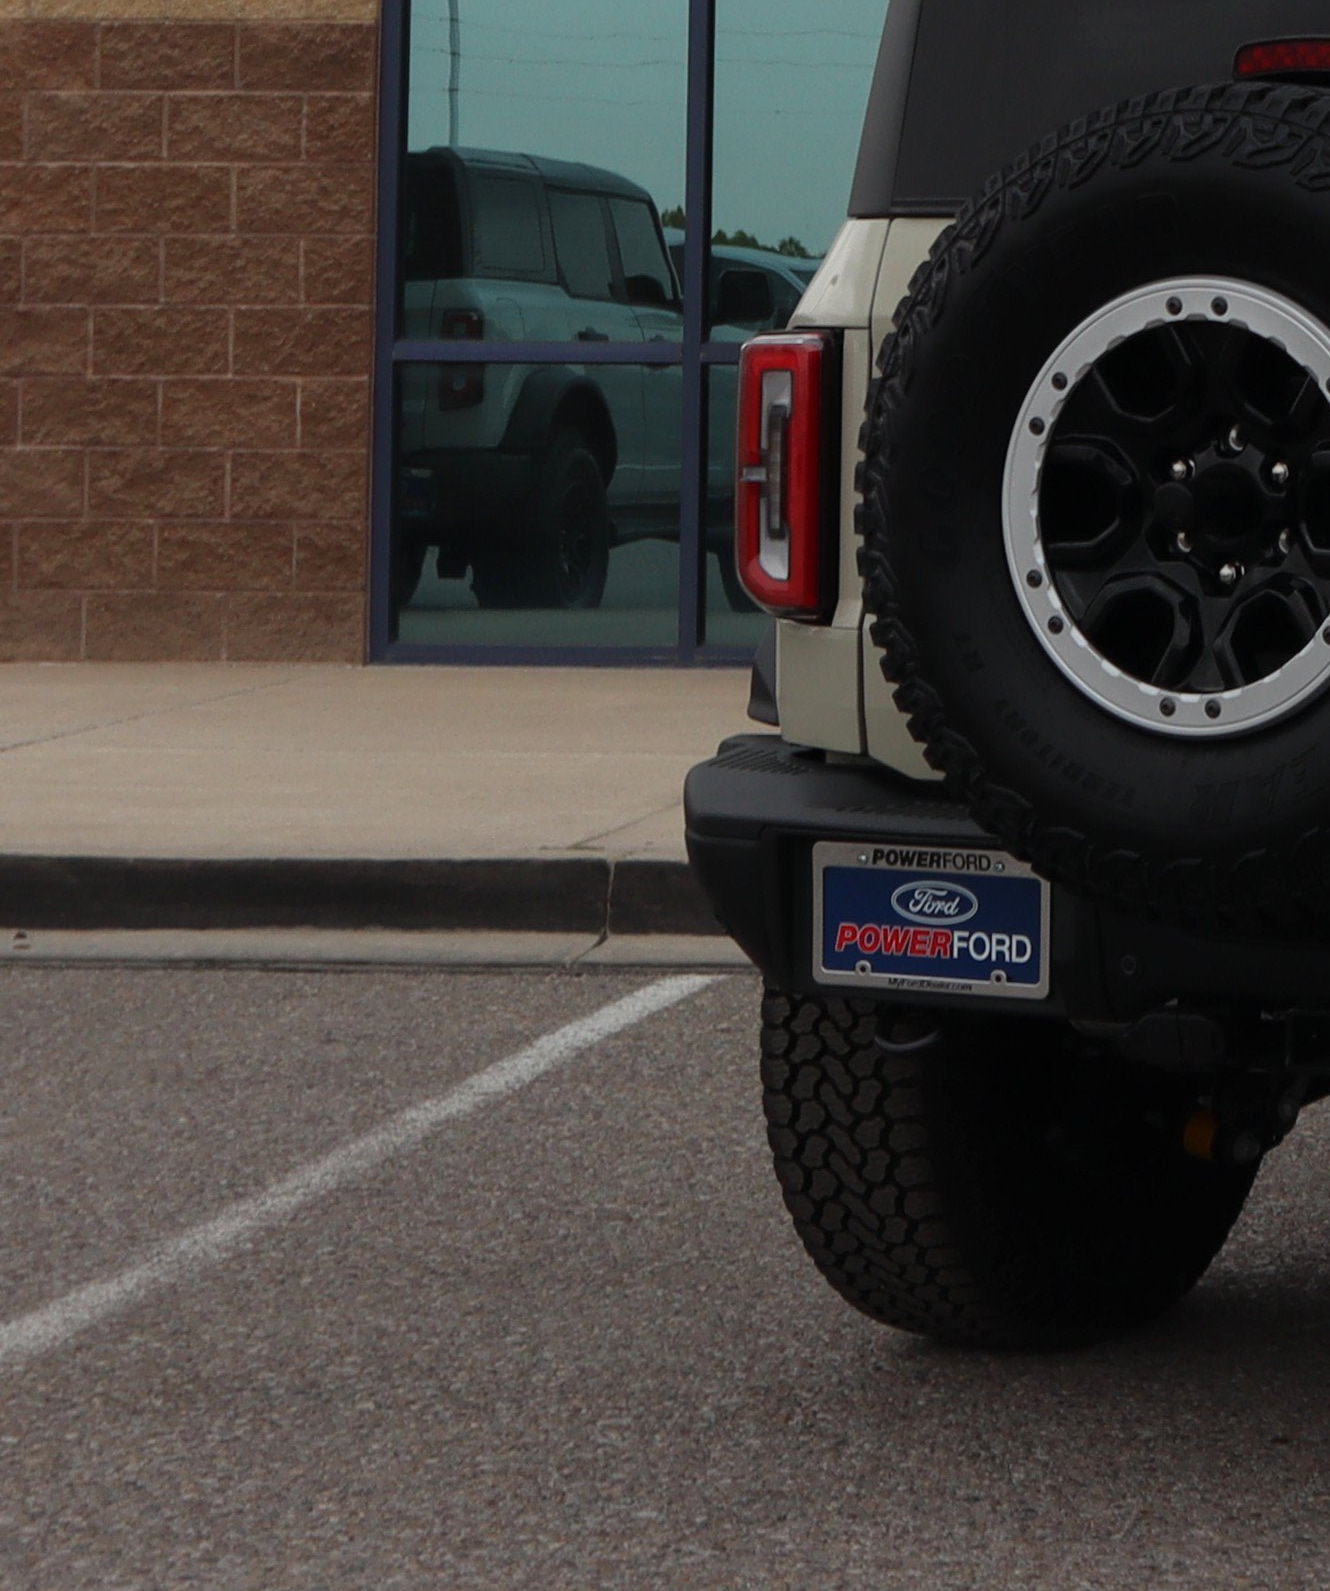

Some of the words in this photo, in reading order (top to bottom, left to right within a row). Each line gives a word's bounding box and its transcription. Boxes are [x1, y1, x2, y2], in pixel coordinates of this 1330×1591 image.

[872, 848, 992, 872] POWERFORD
[909, 888, 960, 916] Ford
[834, 922, 1032, 964] POWERFORD
